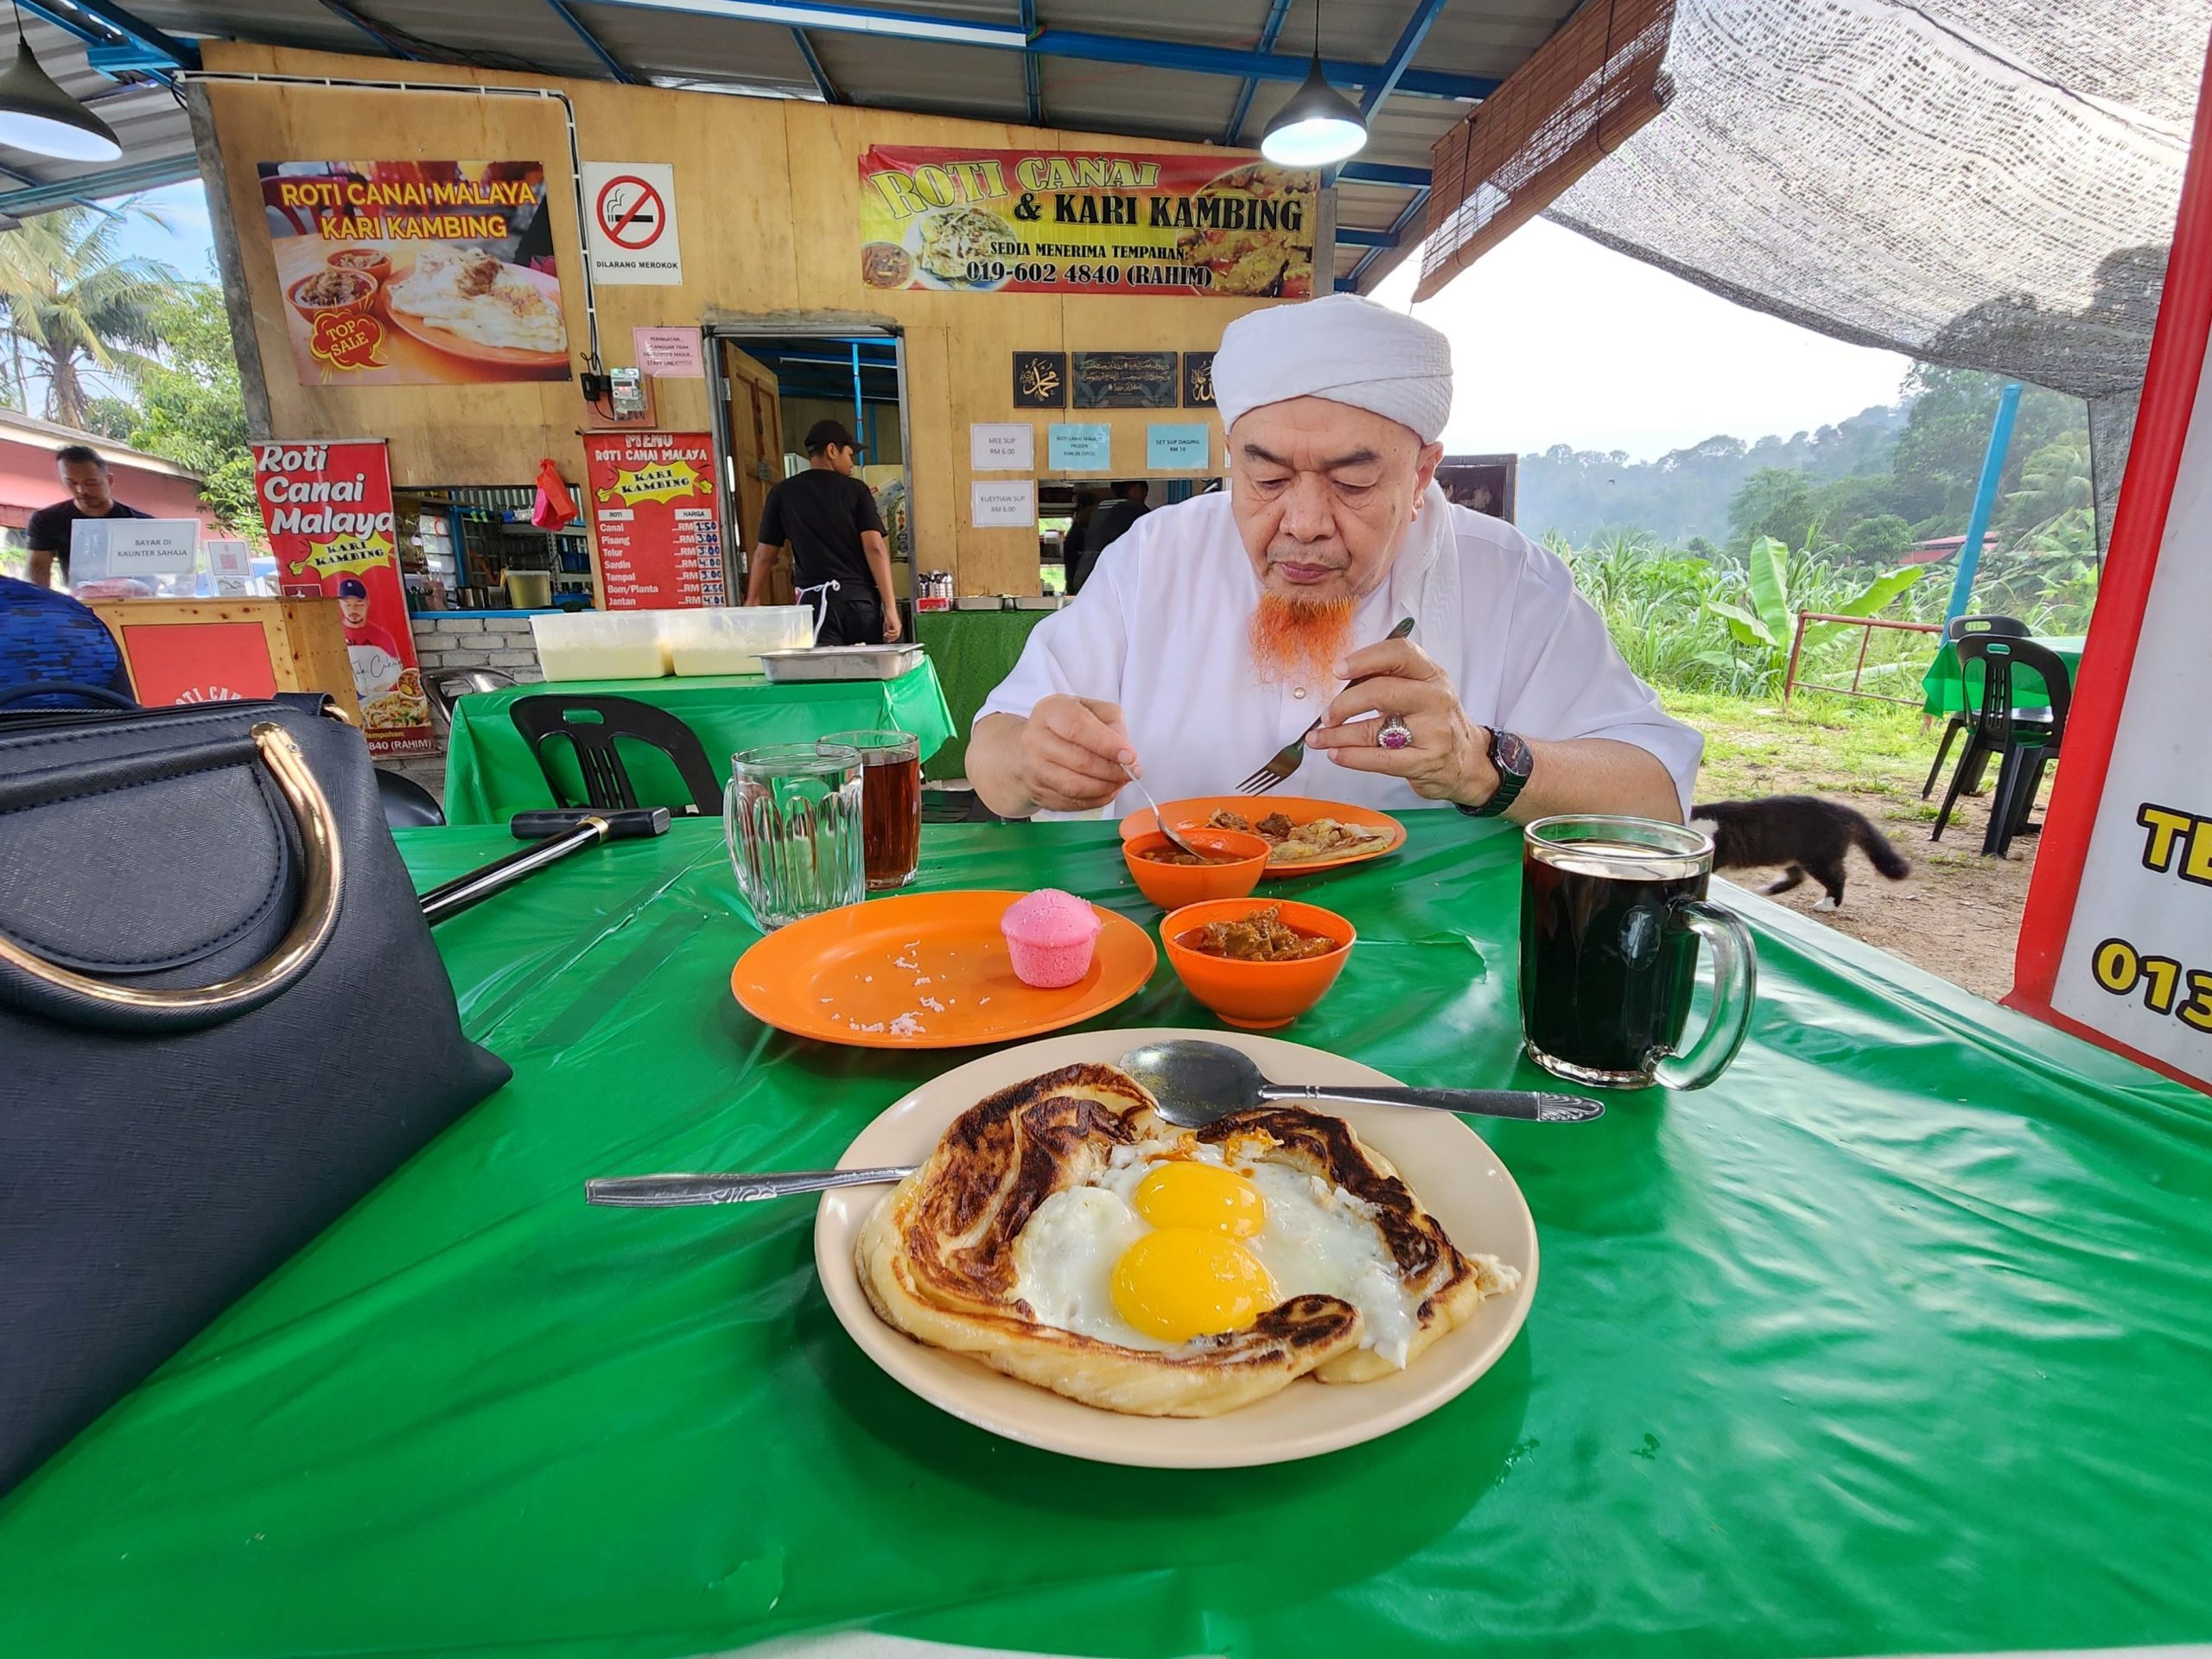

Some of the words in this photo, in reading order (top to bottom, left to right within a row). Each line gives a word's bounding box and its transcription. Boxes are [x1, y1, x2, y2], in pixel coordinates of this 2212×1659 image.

[280, 182, 343, 207] ROTI
[346, 182, 428, 206] CANAI
[432, 181, 537, 205] MALAYA
[869, 161, 1008, 219] ROTI
[1015, 156, 1160, 192] CANAI
[1013, 192, 1043, 223] &
[1053, 192, 1140, 226] KARI
[1149, 194, 1303, 232] KAMBING
[321, 216, 383, 239] KARI
[386, 214, 508, 238] KAMBING
[990, 241, 1030, 256] SEDIA
[1036, 243, 1106, 258] MENERIMA
[1111, 245, 1190, 260] TEMPAHAN:
[966, 260, 1057, 283] 019-602
[1064, 264, 1120, 284] 4840
[1126, 264, 1214, 288] (RAHIM)
[325, 320, 356, 342] TOP
[330, 331, 369, 356] SALE
[625, 434, 674, 448] MENU
[259, 444, 328, 473] Roti
[594, 449, 621, 461] ROTI
[626, 449, 658, 461] CANAI
[662, 448, 708, 461] MALAYA
[633, 469, 673, 482] KARI
[264, 473, 365, 504] Canai
[620, 477, 690, 494] KAMBING
[270, 505, 394, 541] Malaya
[600, 523, 625, 532] Canai
[327, 541, 366, 554] KARI
[601, 536, 631, 546] Pisang
[315, 549, 385, 566] KAMBING
[602, 548, 623, 556] Telur
[604, 560, 632, 569] Sardin
[607, 584, 658, 594] Bom/Planta
[608, 597, 636, 607] Jantan
[391, 740, 432, 752] (RAHIM)
